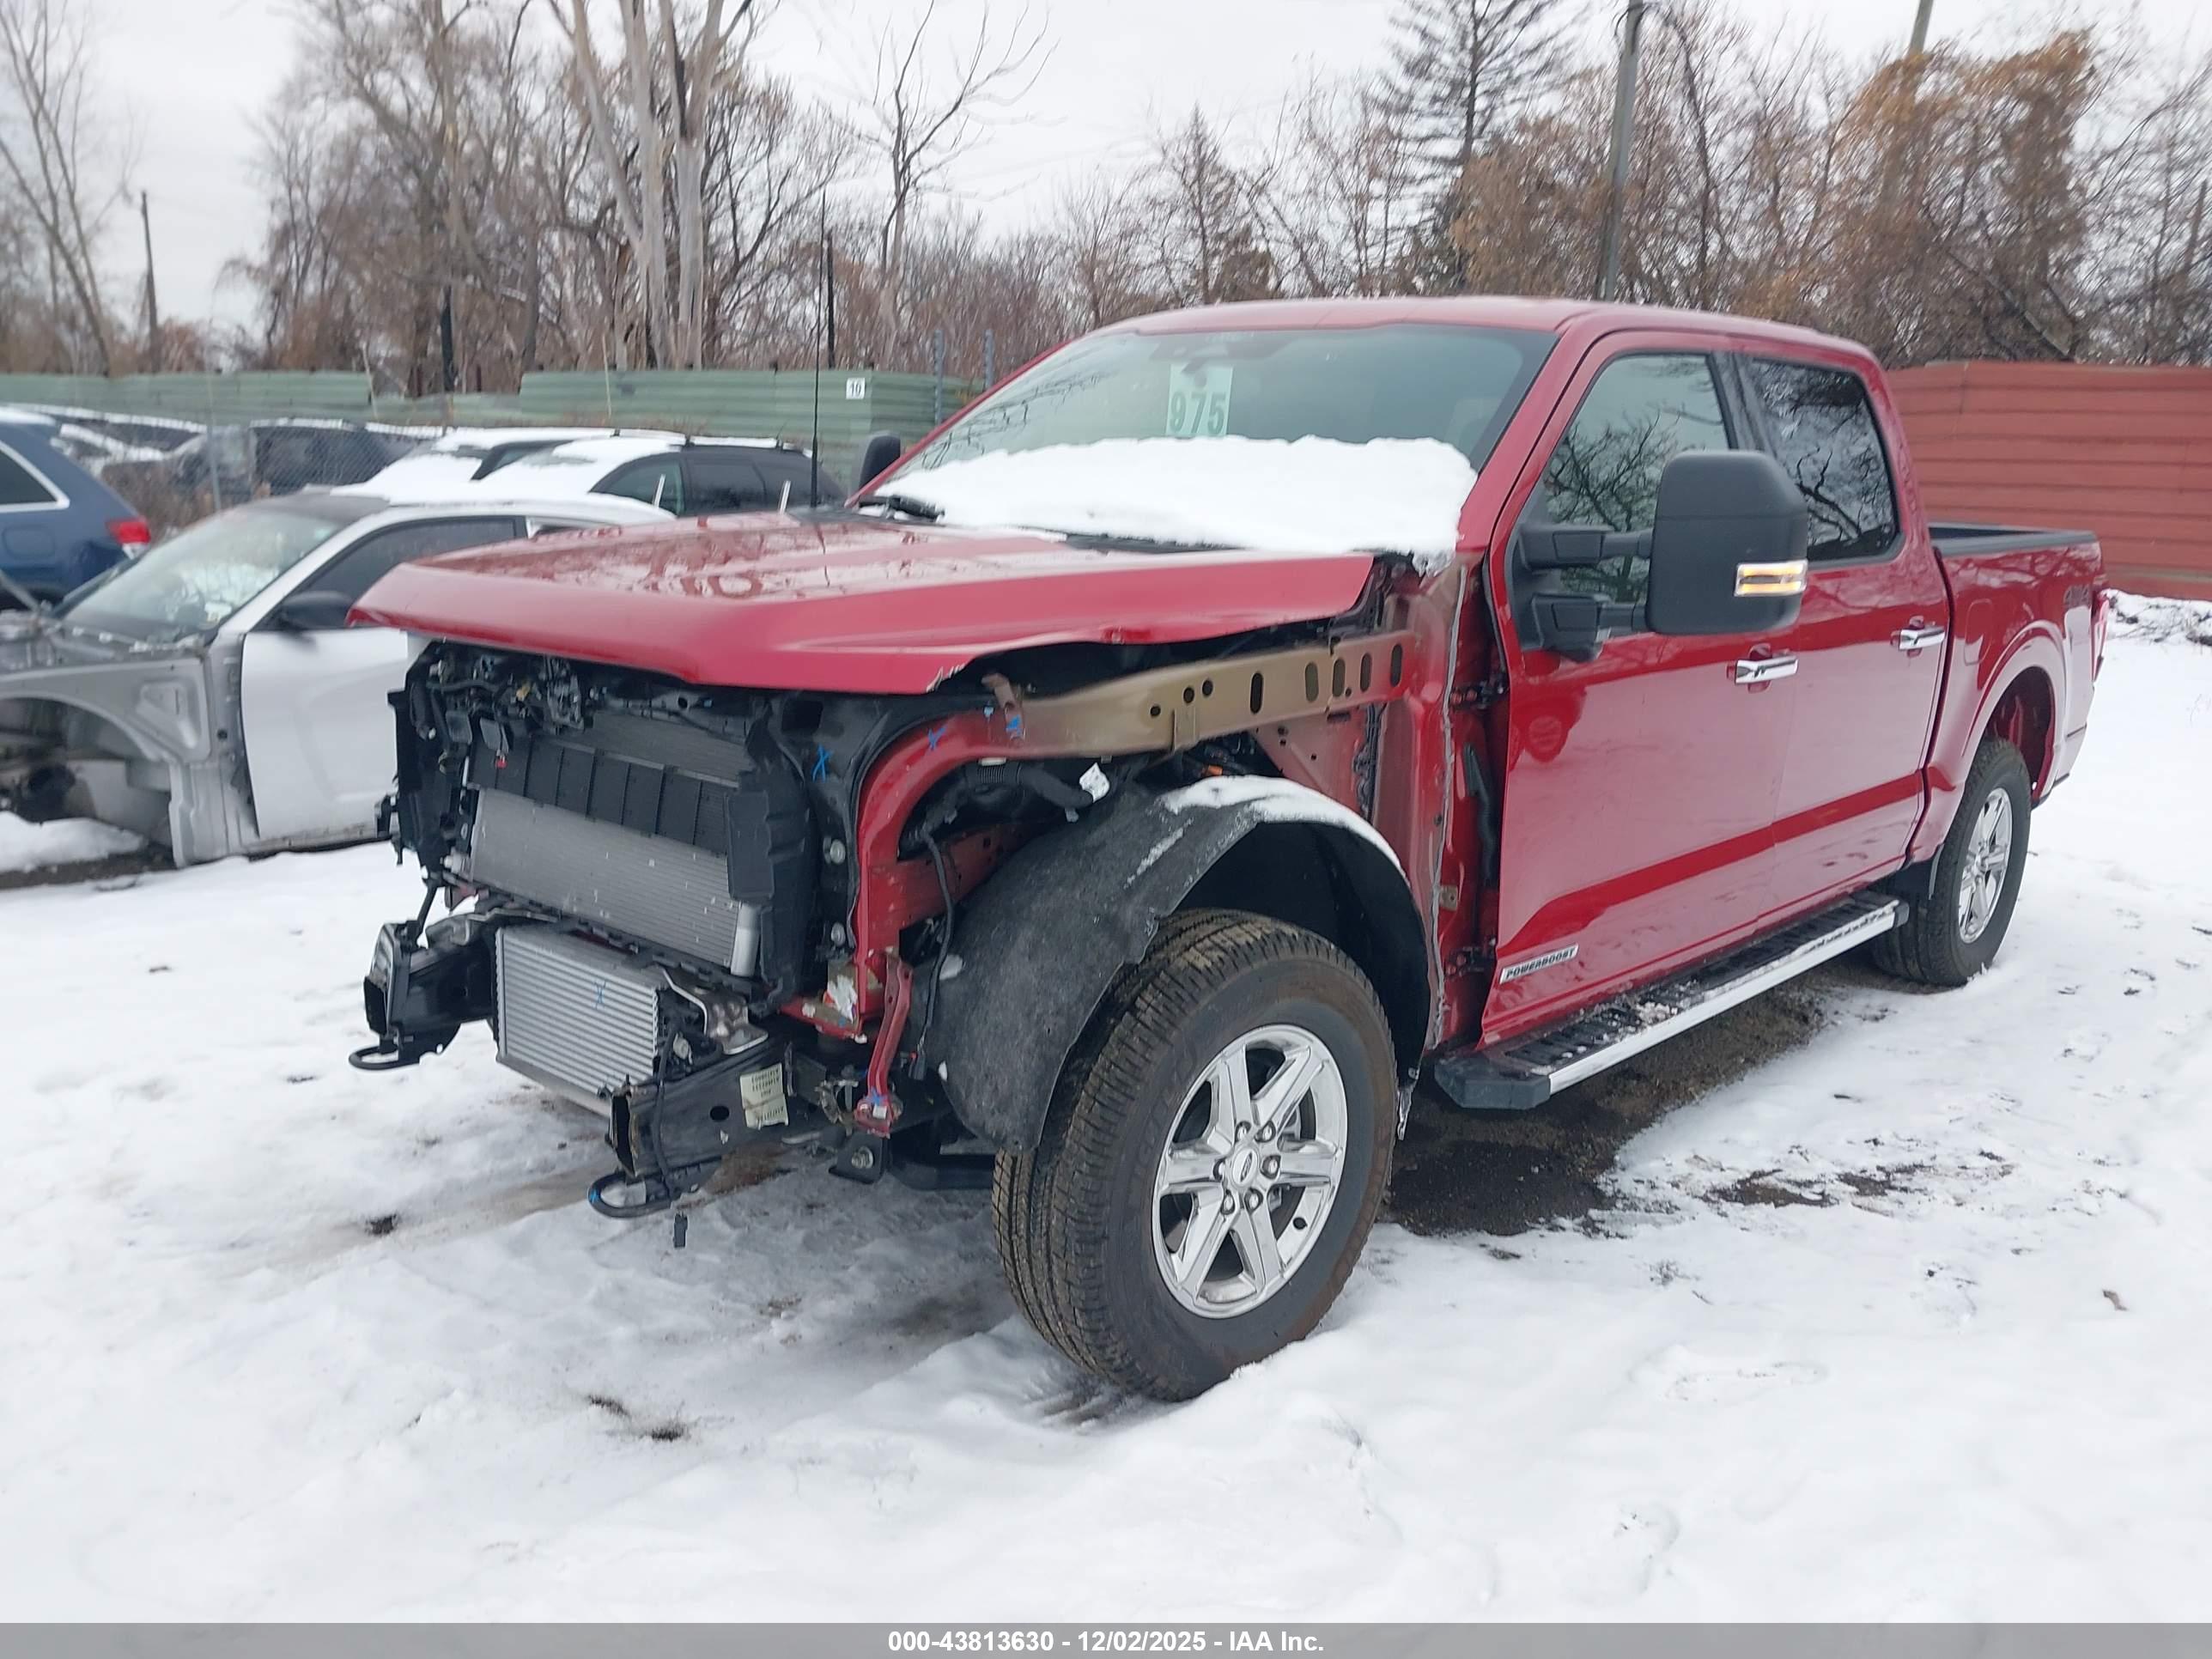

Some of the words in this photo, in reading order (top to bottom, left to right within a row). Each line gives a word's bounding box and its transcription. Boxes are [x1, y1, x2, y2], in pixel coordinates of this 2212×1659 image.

[851, 383, 861, 397] 10
[1170, 392, 1226, 434] 975
[1506, 948, 1576, 978] POWERBOOST
